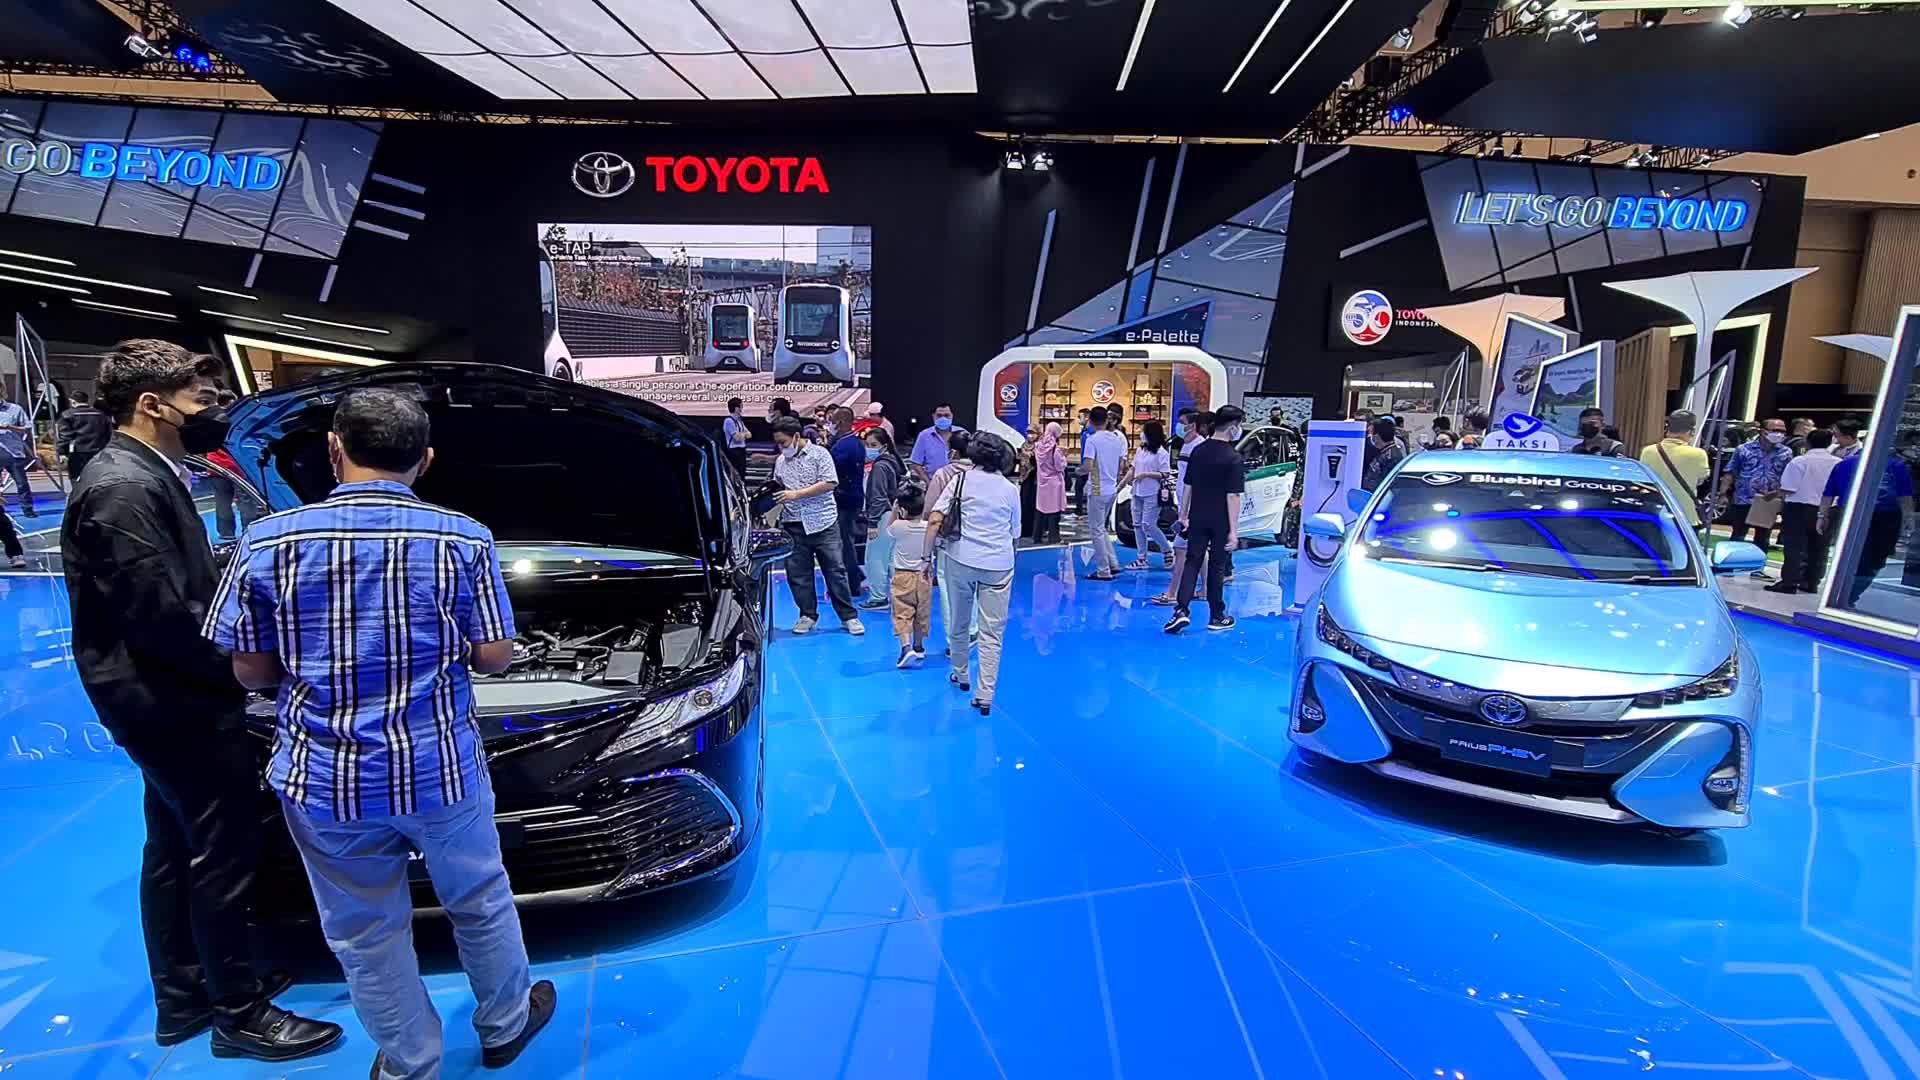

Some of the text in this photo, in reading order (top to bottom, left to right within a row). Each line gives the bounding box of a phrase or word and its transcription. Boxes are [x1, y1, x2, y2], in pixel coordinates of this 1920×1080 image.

[79, 142, 282, 191] BEYOND
[646, 156, 829, 193] TOYOTA
[1454, 191, 1748, 232] LET'S GO BEYOND
[549, 242, 592, 254] e-TAP
[1126, 329, 1200, 343] e-Palette
[621, 380, 650, 391] single
[652, 382, 688, 392] person
[769, 382, 805, 392] control
[807, 383, 839, 393] center
[1496, 438, 1547, 449] TAKSI
[1469, 474, 1626, 493] Bluebird Group
